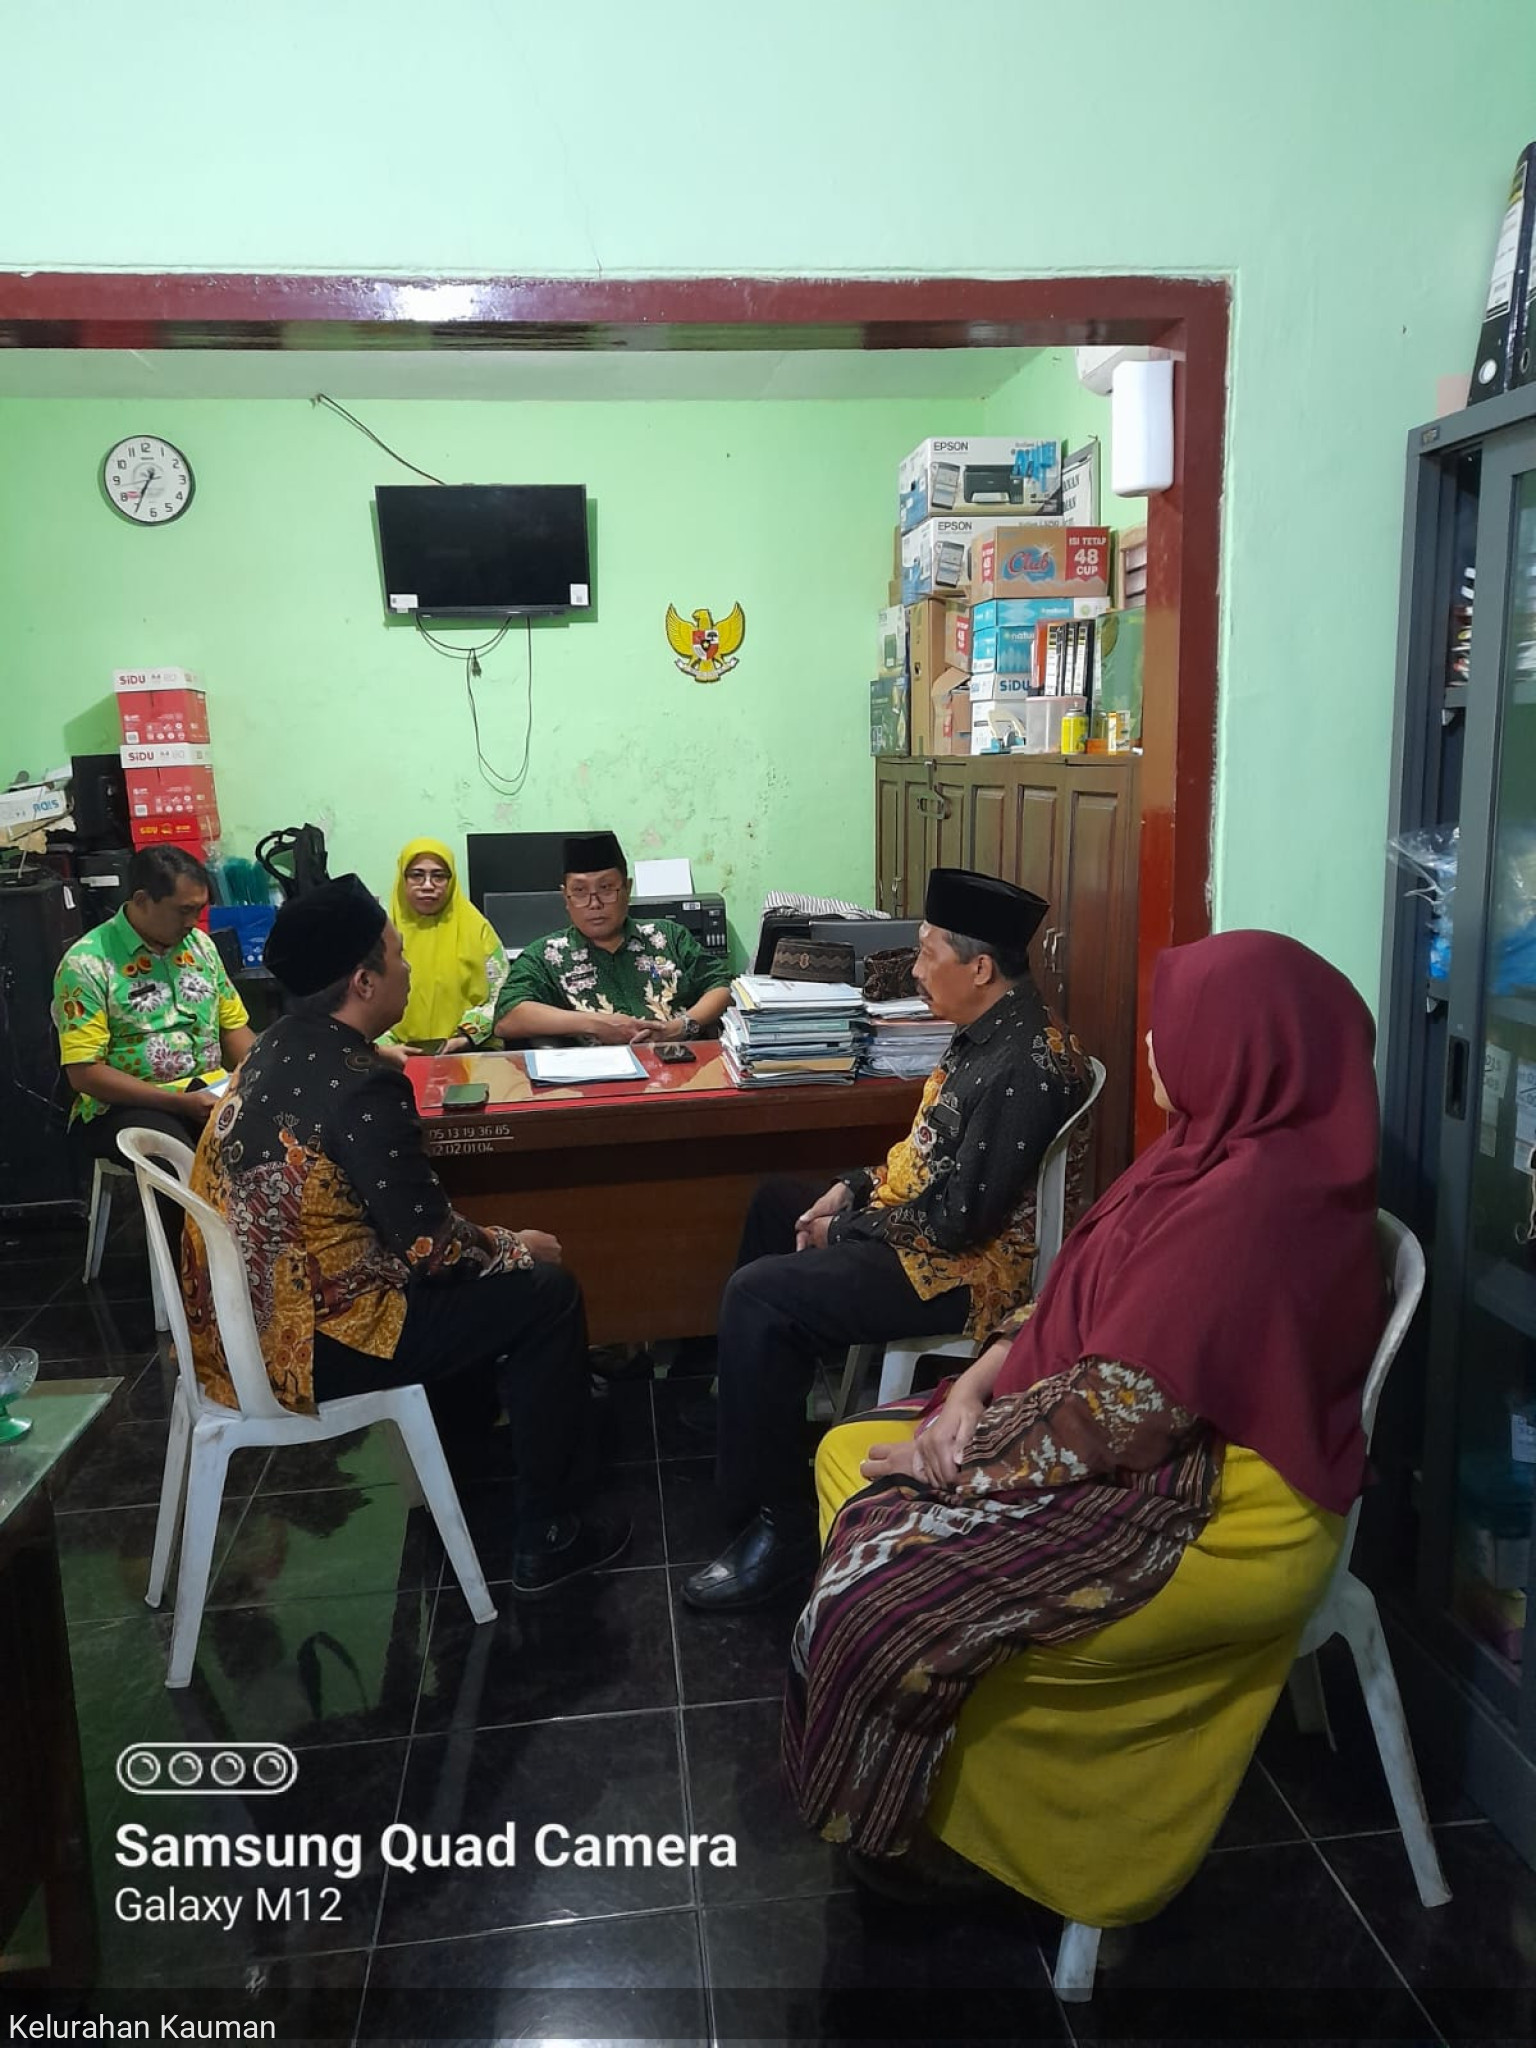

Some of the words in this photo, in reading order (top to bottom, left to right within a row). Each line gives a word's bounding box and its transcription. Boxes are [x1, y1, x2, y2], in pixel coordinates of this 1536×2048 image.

[128, 447, 135, 457] 11
[140, 442, 151, 453] 12
[160, 447, 165, 457] 1
[933, 441, 969, 452] EPSON
[117, 459, 127, 470] 10
[172, 458, 180, 469] 2
[113, 475, 121, 486] 9
[178, 474, 187, 485] 3
[120, 492, 128, 502] 8
[176, 491, 183, 500] 4
[134, 502, 140, 513] 7
[149, 507, 158, 518] 6
[164, 502, 173, 512] 5
[938, 521, 972, 531] EPSON
[1074, 548, 1099, 565] 48
[1008, 550, 1050, 575] Club
[1076, 565, 1098, 576] CUP
[119, 675, 146, 686] SiDU
[128, 752, 154, 761] SiDU
[447, 1127, 460, 1138] 13
[463, 1126, 475, 1138] 19
[479, 1125, 493, 1136] 36
[446, 1143, 461, 1155] 02
[463, 1142, 476, 1154] 01
